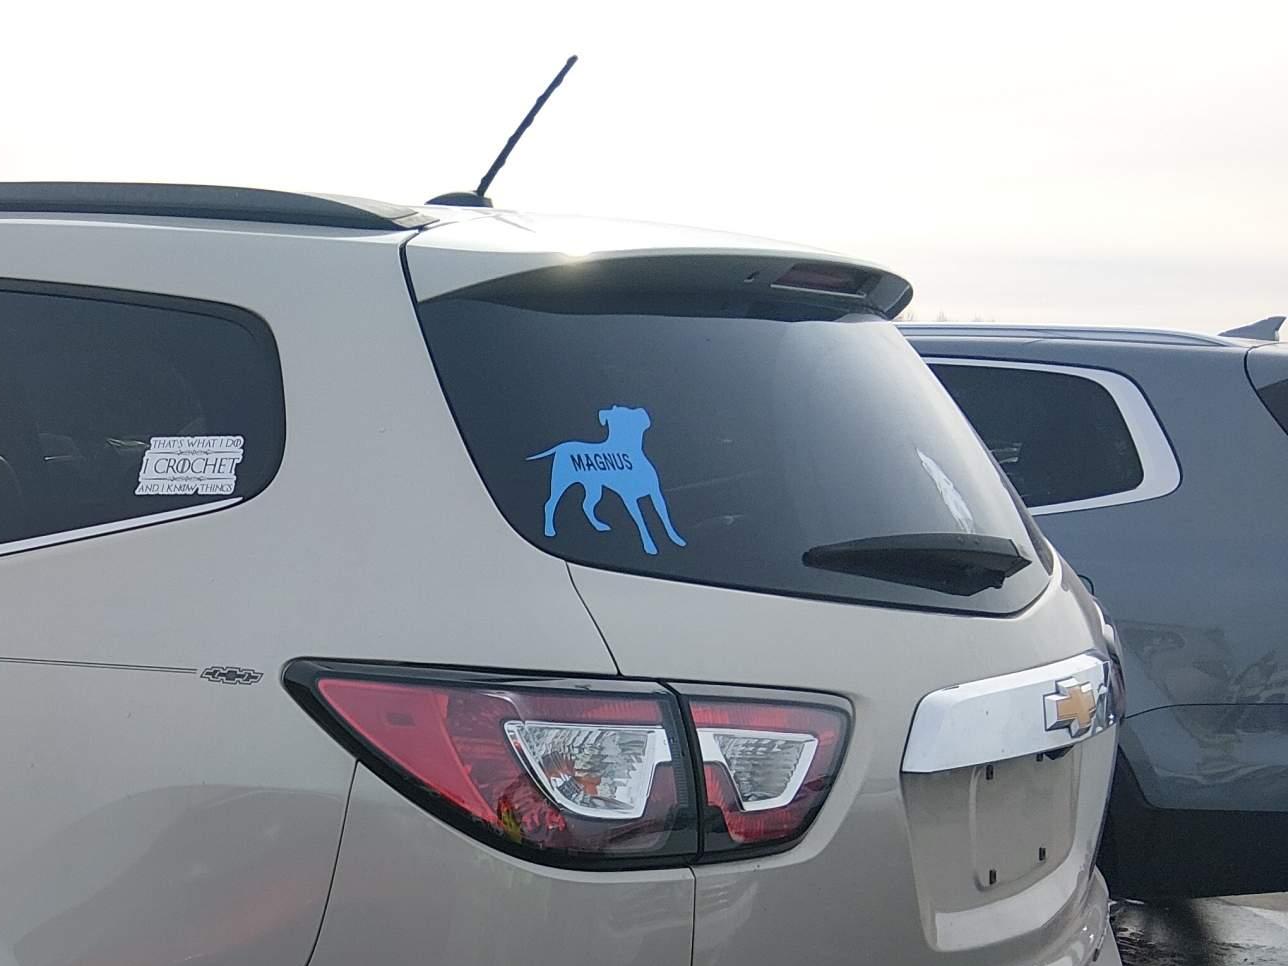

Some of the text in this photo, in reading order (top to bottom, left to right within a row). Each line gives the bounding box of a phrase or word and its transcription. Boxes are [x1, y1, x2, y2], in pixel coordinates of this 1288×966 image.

[187, 439, 218, 448] WHAT
[225, 439, 242, 448] DO
[143, 457, 240, 474] I CROCHET
[570, 453, 633, 472] MAGNUS
[138, 483, 159, 493] AND
[166, 483, 198, 493] KNOW
[200, 483, 233, 493] THINGS
